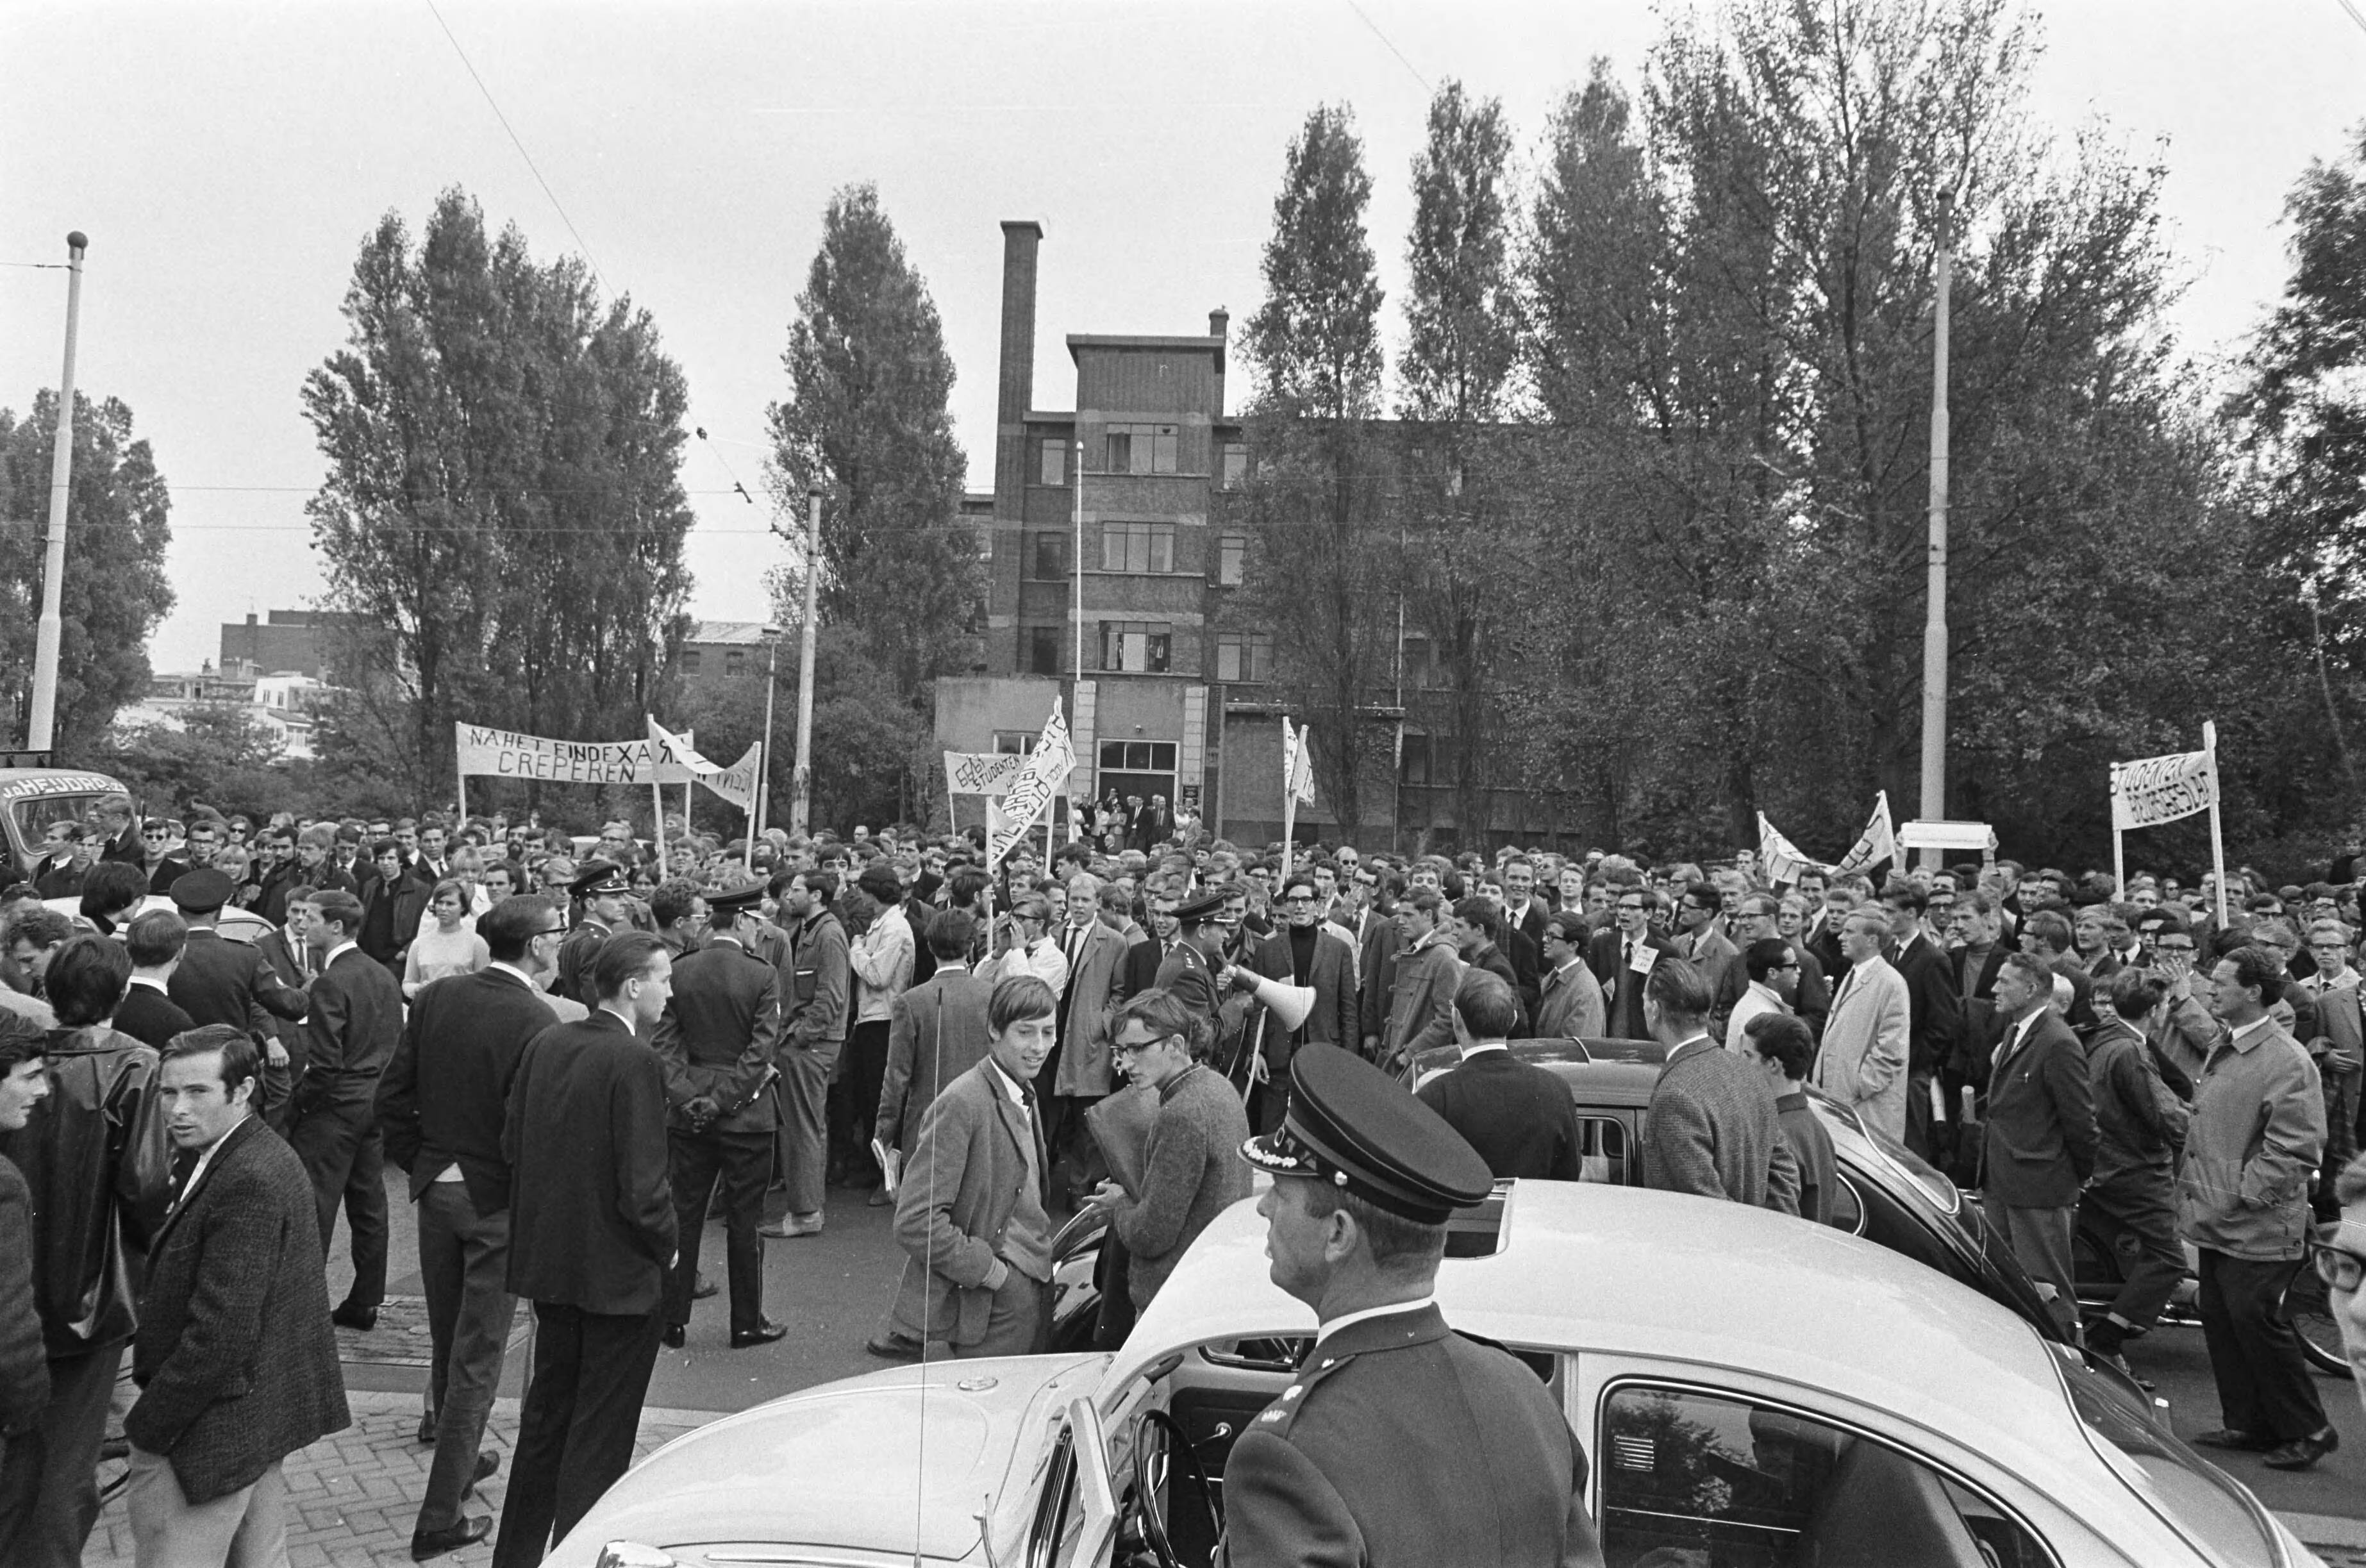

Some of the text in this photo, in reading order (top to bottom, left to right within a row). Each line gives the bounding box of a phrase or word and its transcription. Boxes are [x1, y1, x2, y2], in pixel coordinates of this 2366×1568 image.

[498, 751, 635, 783] CREPEREN
[554, 741, 653, 764] EINDEXA
[974, 755, 1021, 792] STUDENTEN
